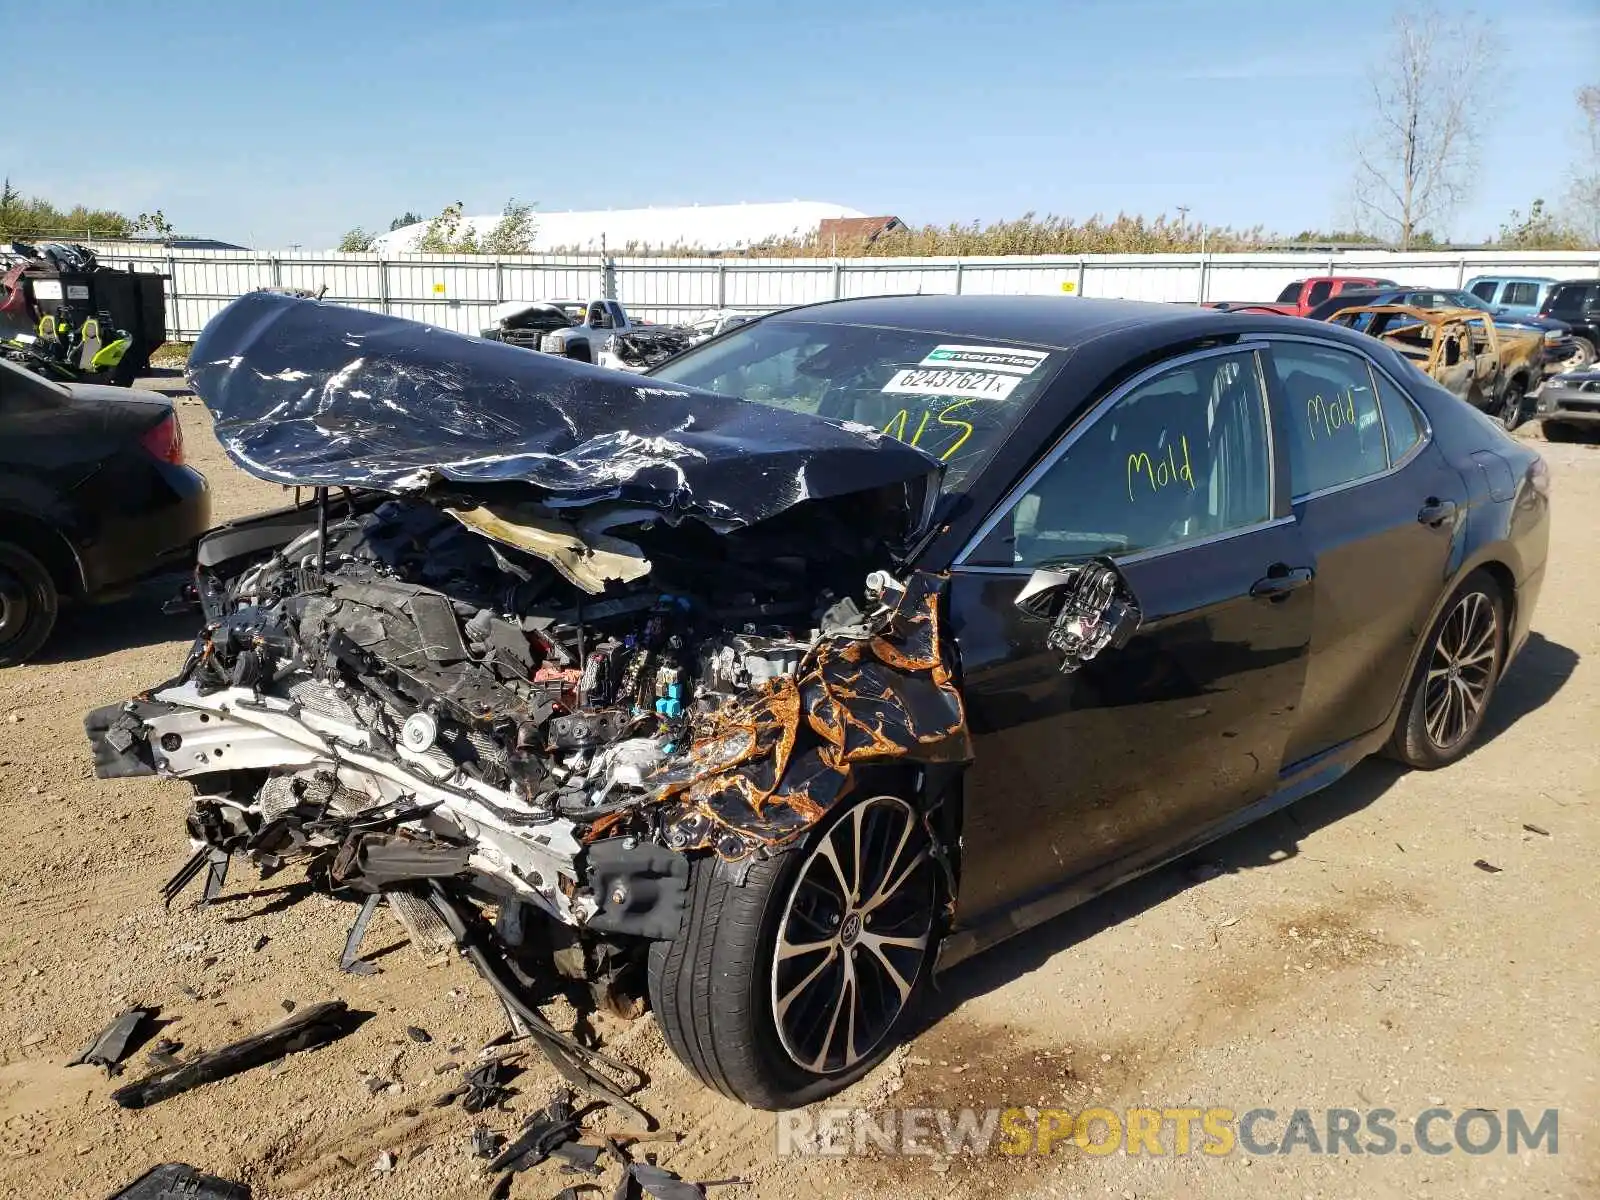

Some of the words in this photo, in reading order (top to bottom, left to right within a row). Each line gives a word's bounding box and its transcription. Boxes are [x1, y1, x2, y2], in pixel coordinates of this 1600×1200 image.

[936, 351, 1039, 367] enterprise
[1307, 390, 1356, 441] Mold
[1127, 434, 1196, 502] Mold
